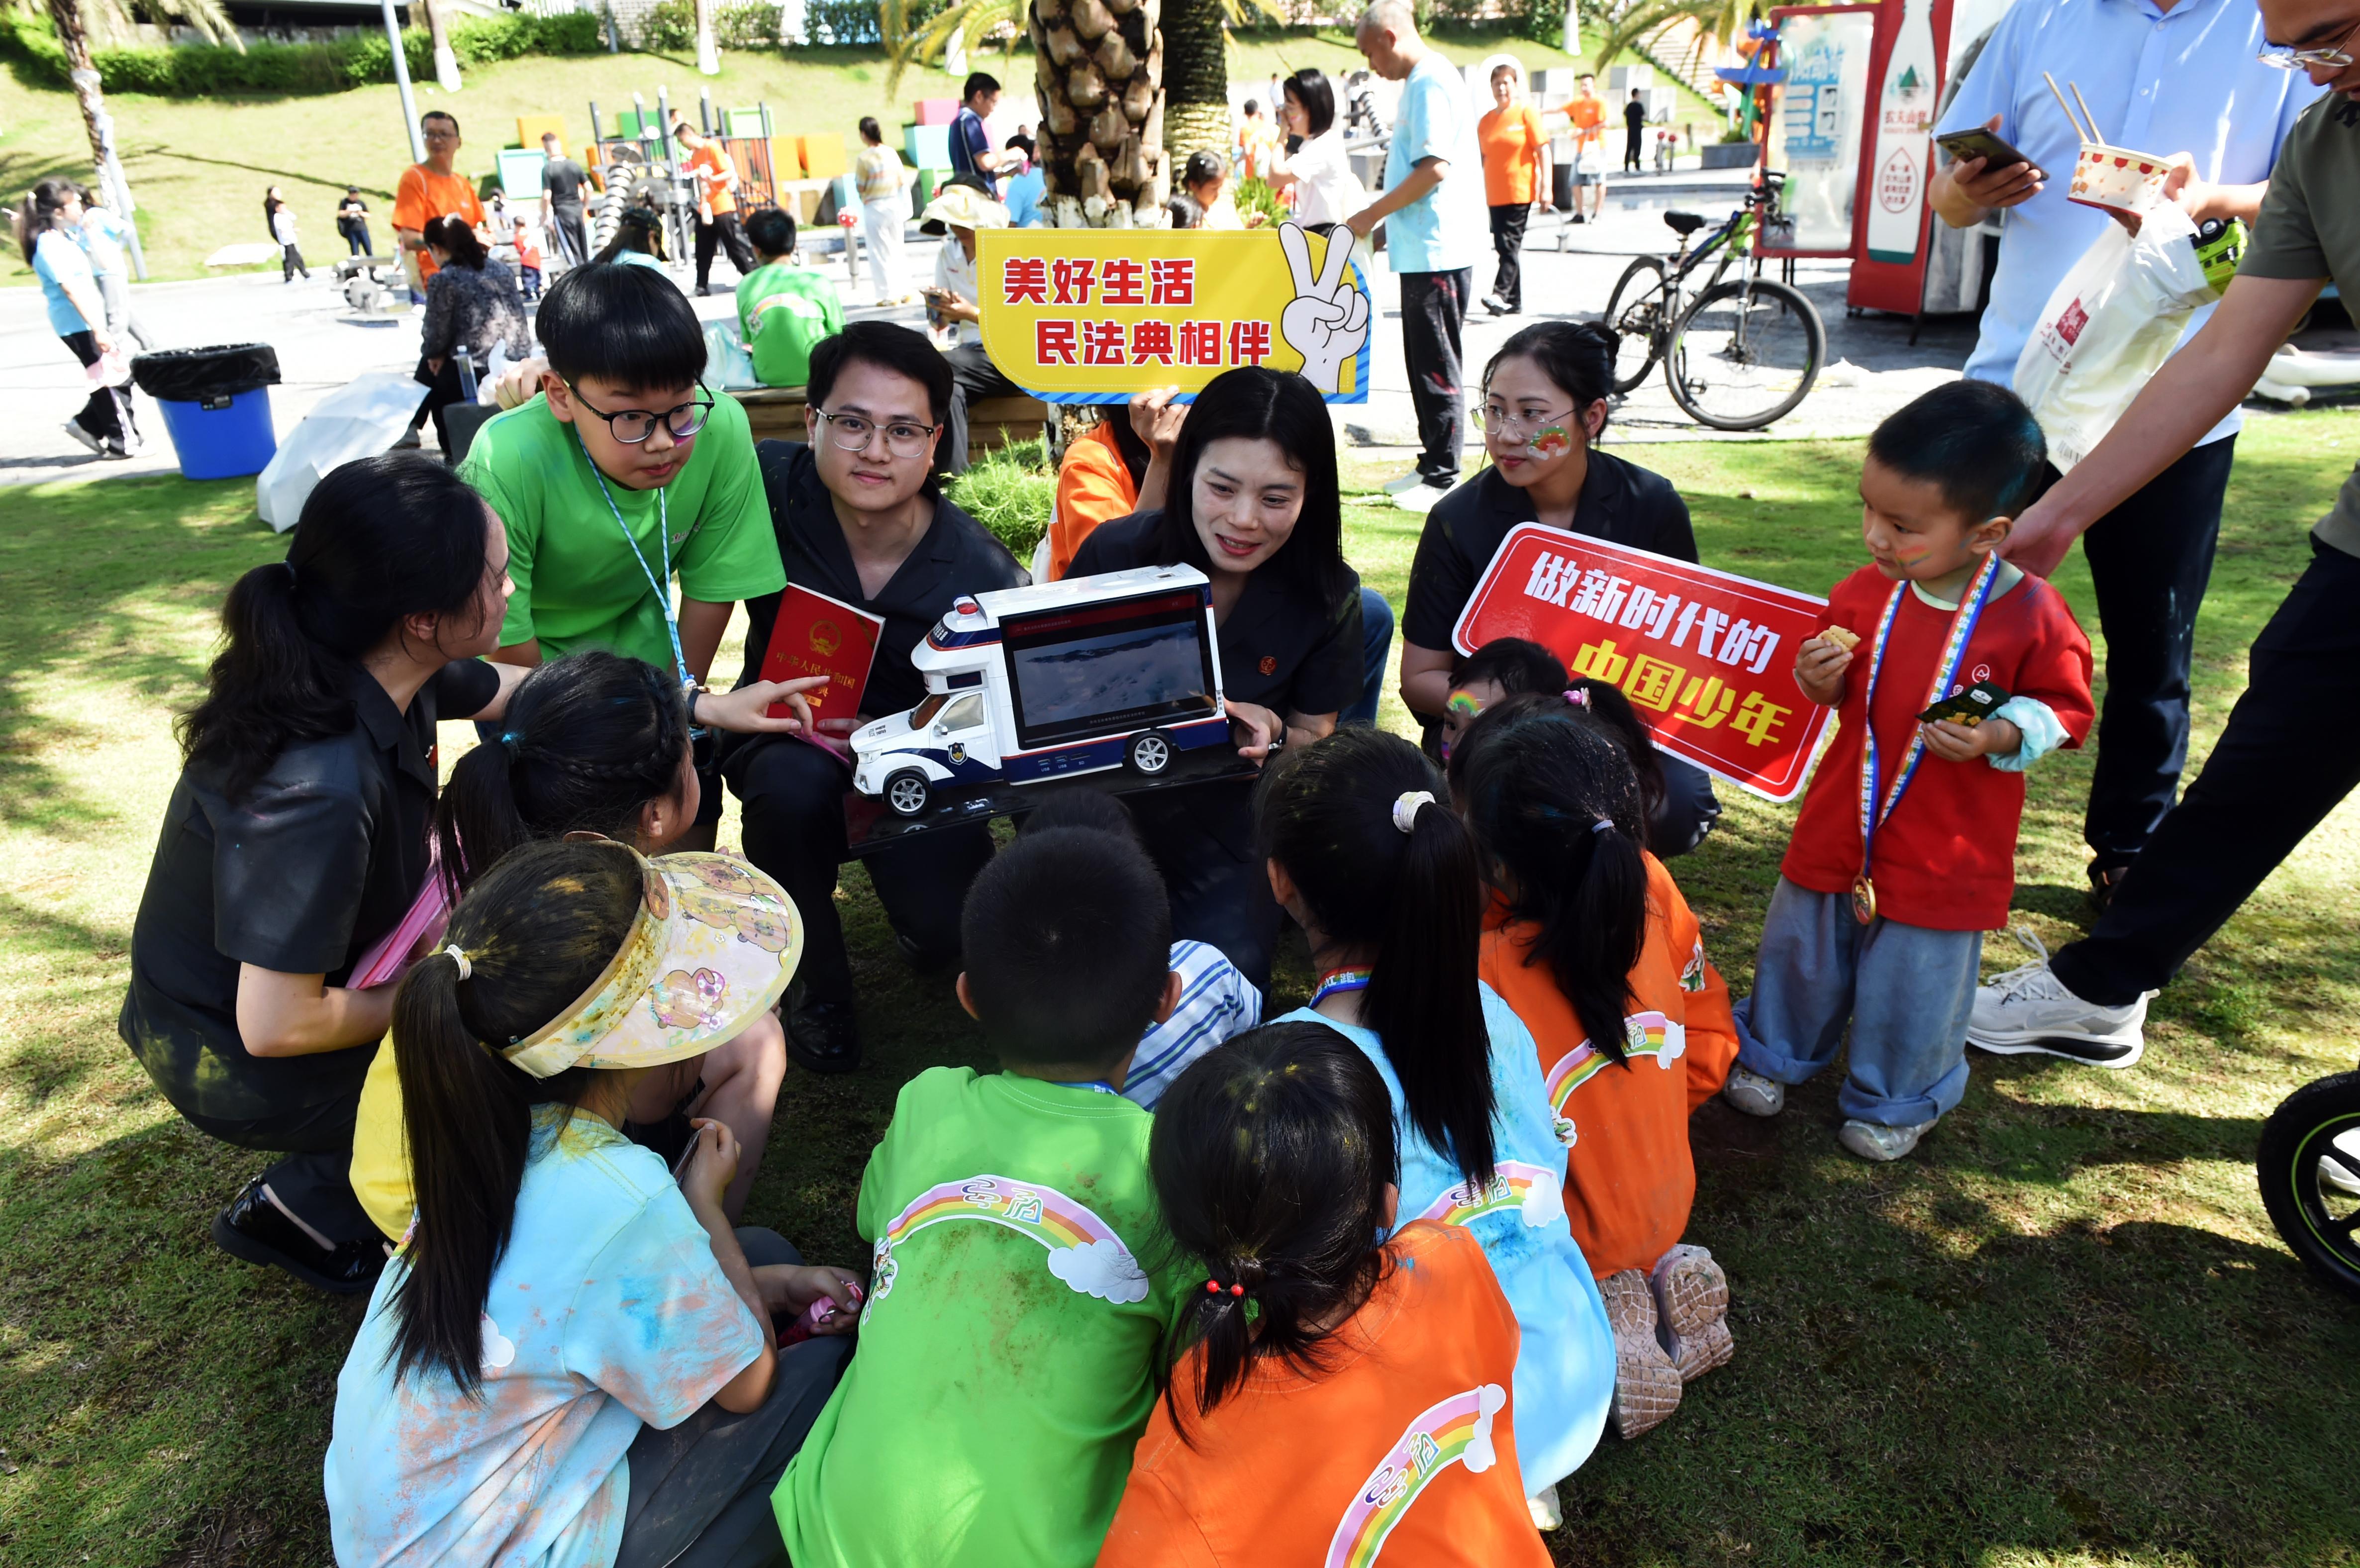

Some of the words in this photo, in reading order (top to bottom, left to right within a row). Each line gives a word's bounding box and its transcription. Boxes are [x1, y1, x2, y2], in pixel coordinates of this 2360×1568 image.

[1003, 258, 1195, 306] 美好生活
[1035, 319, 1272, 367] 民法典相伴
[1524, 551, 1780, 674] 做新时代的
[1571, 639, 1792, 747] 中国少年
